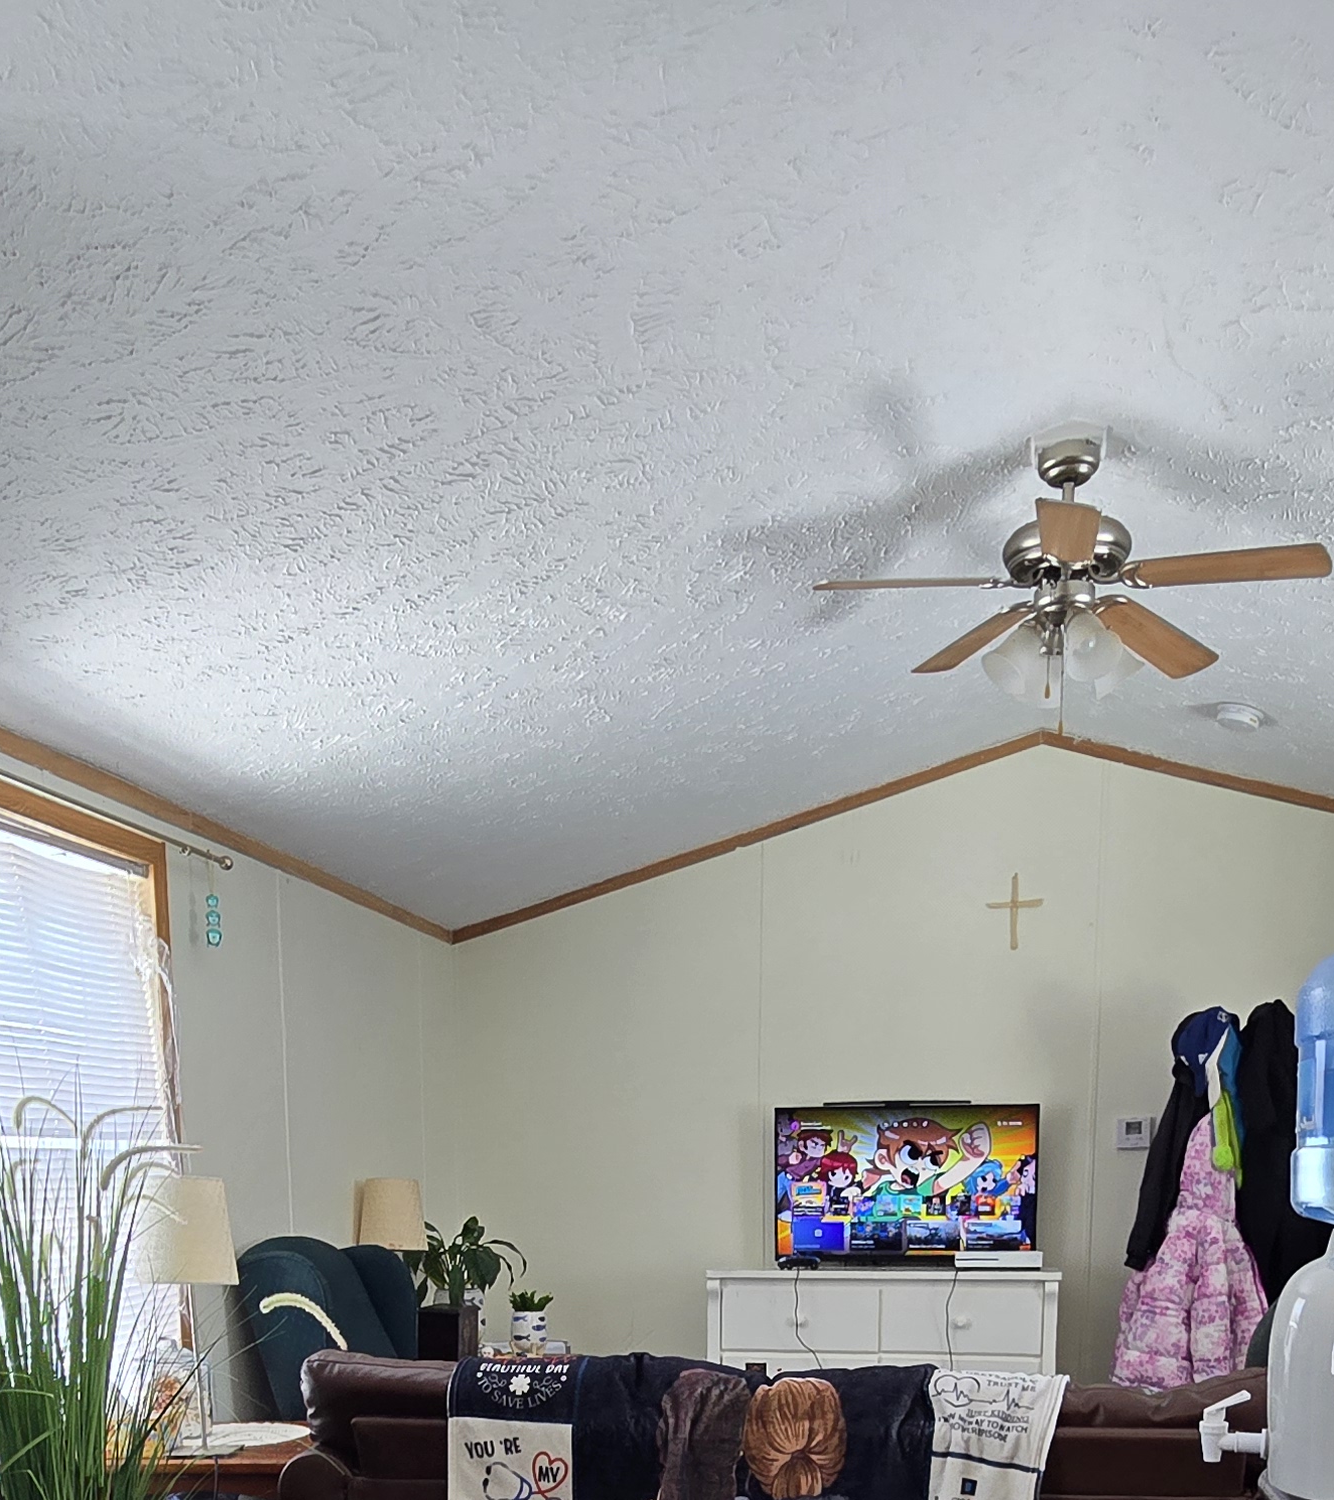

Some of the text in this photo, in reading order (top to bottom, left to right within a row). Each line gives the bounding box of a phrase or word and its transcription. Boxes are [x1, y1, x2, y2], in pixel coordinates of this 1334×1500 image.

[545, 1364, 570, 1373] DAY
[478, 1377, 563, 1409] TO SAVE LIVES
[987, 1420, 999, 1429] TO
[464, 1439, 495, 1459] YOU
[538, 1465, 560, 1483] MY
